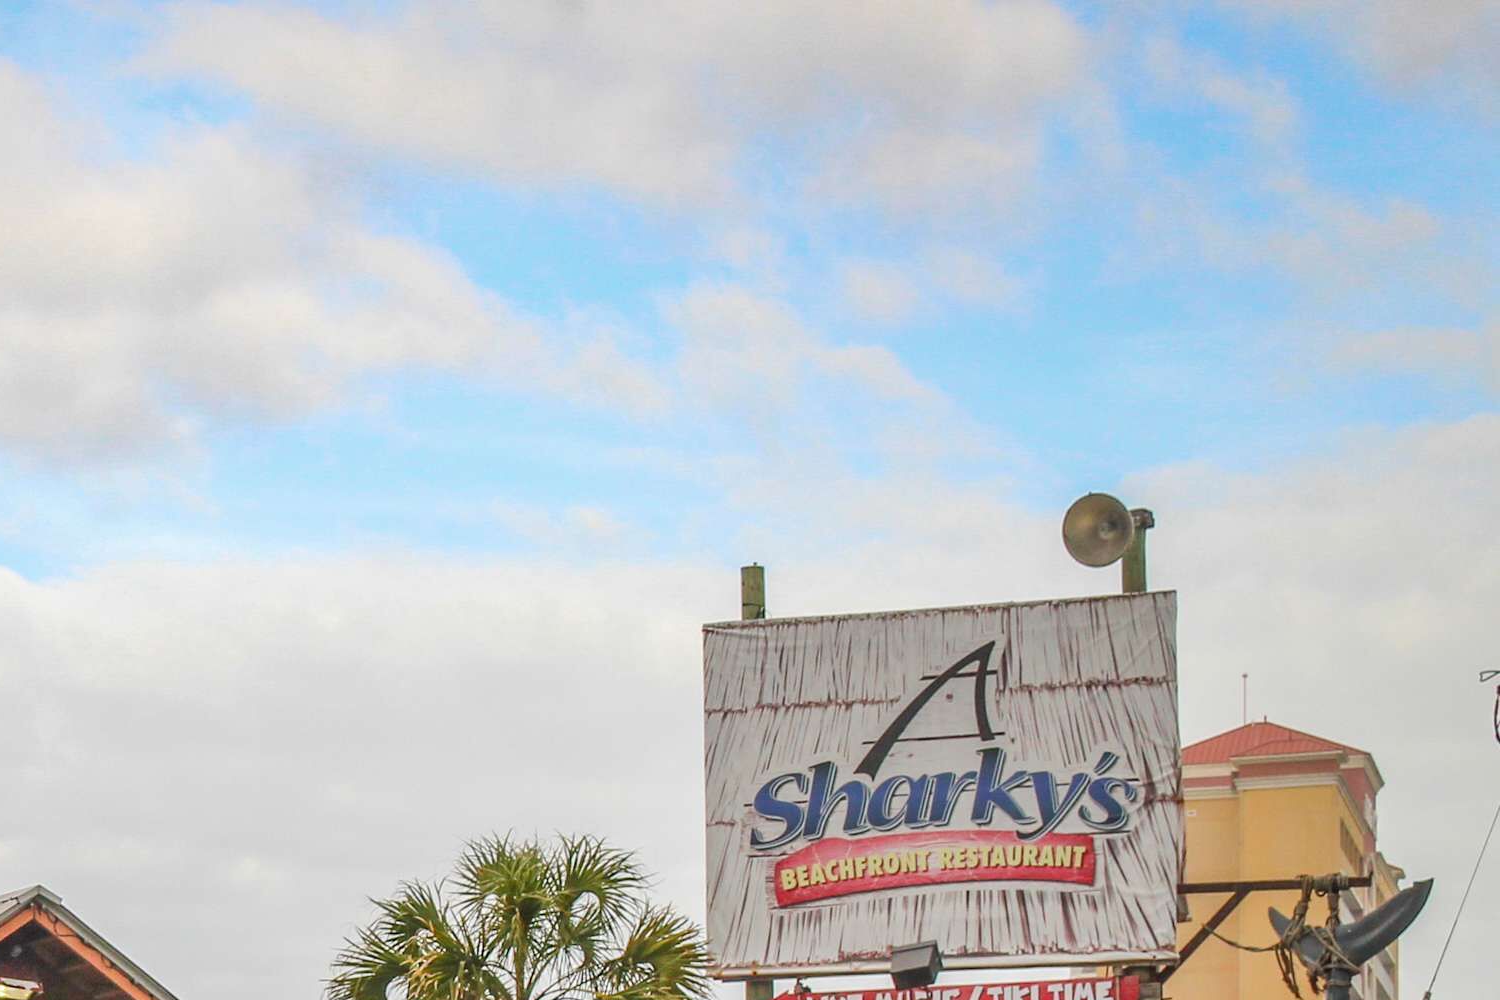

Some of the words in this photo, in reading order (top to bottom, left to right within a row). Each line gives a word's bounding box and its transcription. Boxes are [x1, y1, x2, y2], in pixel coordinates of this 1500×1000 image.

[750, 747, 1139, 851] Sharky's
[779, 847, 933, 893] BEACHFRONT
[938, 844, 1088, 873] RESTAURANT
